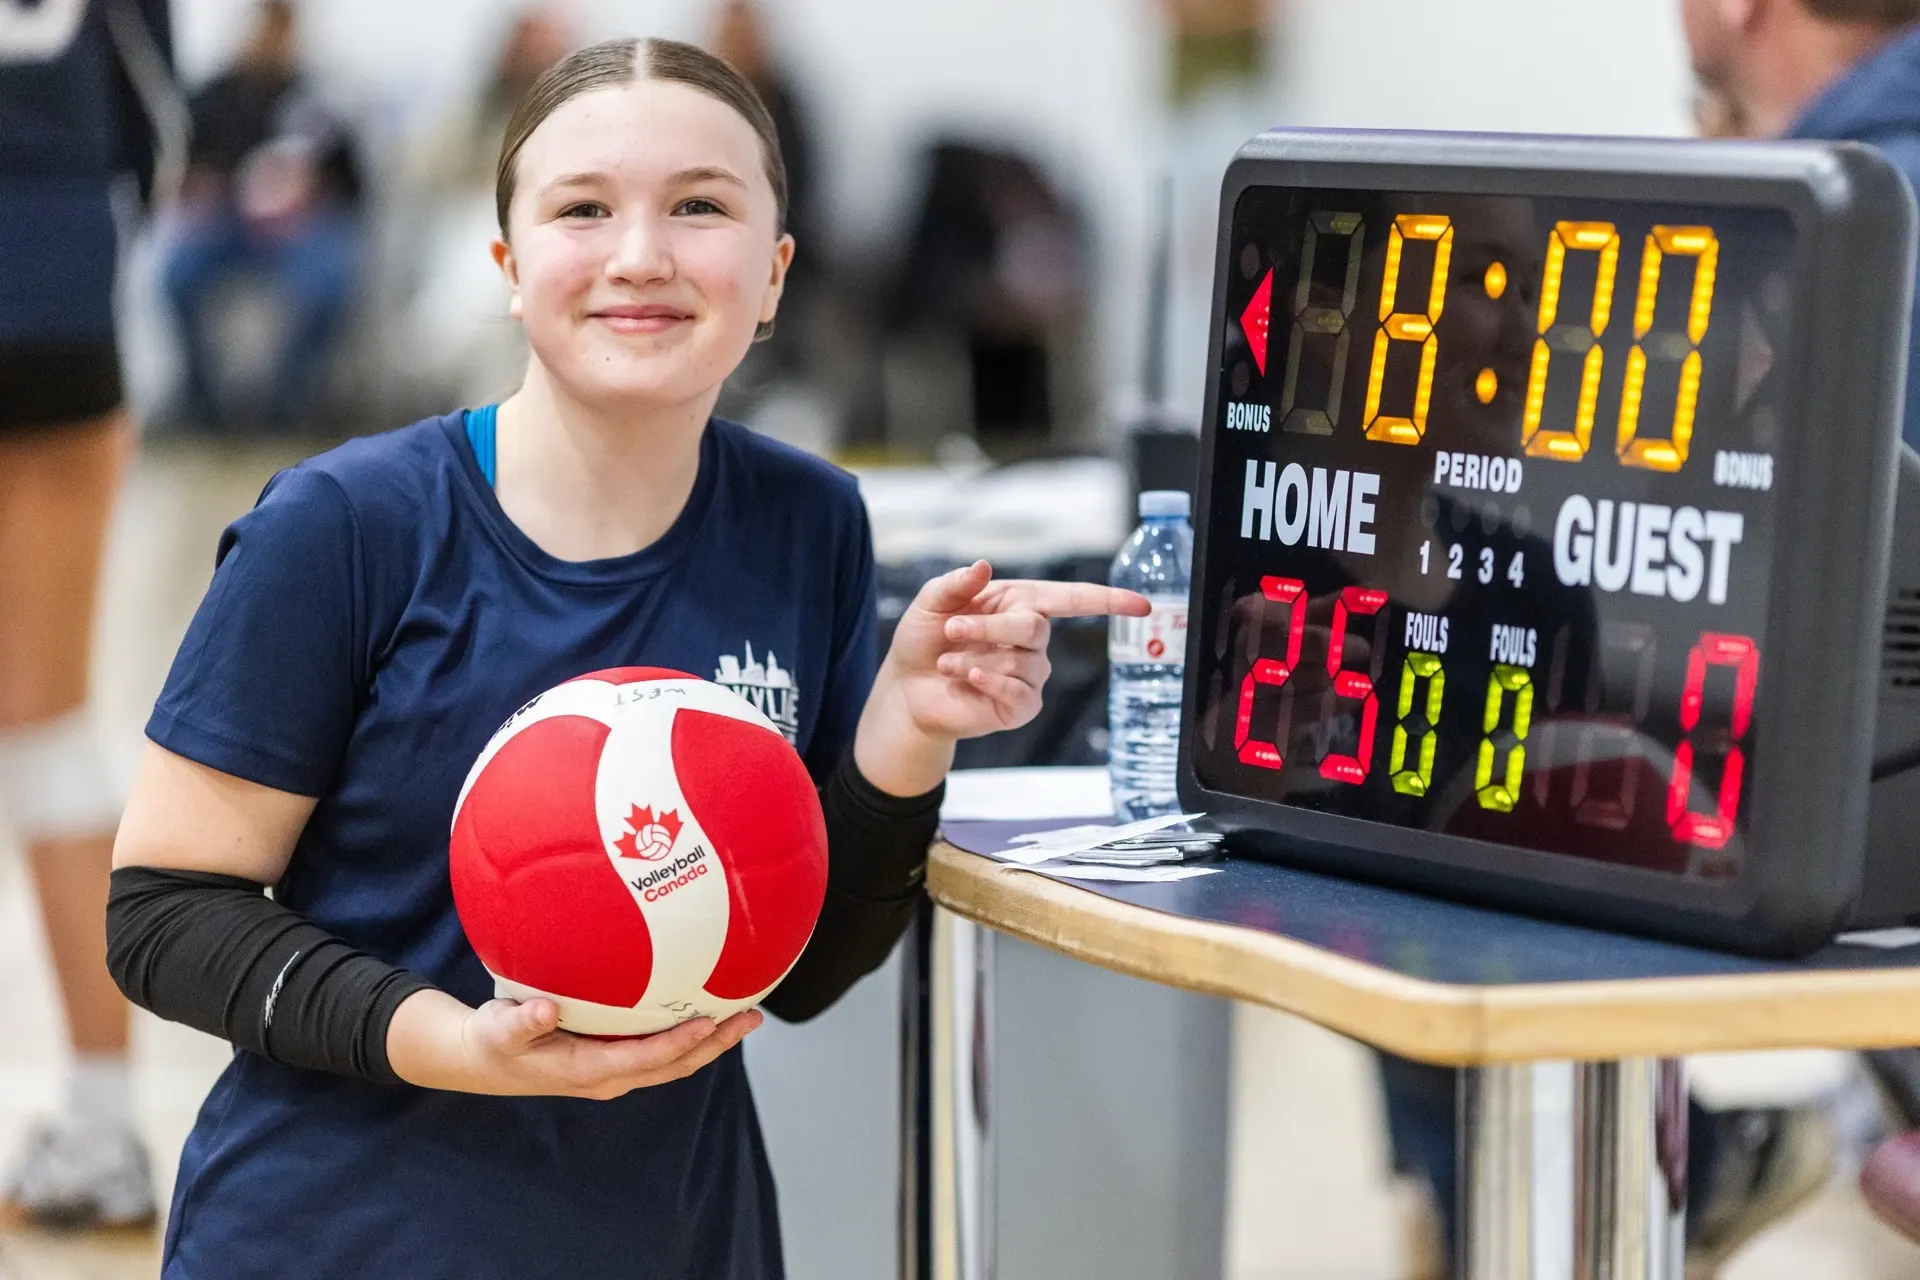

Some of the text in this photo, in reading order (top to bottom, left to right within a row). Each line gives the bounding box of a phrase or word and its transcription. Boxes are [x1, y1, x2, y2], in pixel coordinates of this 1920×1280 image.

[1362, 213, 1719, 473] 8:00
[1226, 402, 1271, 433] BONUS
[1434, 450, 1523, 493] PERIOD
[1714, 449, 1774, 491] BONUS
[1240, 458, 1381, 555] HOME
[1419, 540, 1524, 588] 1 2 3 4
[1553, 494, 1744, 605] GUEST
[1404, 611, 1449, 653] FOULS
[1489, 624, 1537, 668] FOULS
[1234, 575, 1389, 785] 25
[1388, 651, 1445, 797] 0
[1474, 664, 1534, 813] 0
[1666, 631, 1760, 850] 0
[631, 845, 706, 891] Volleyball
[644, 863, 708, 902] Canada
